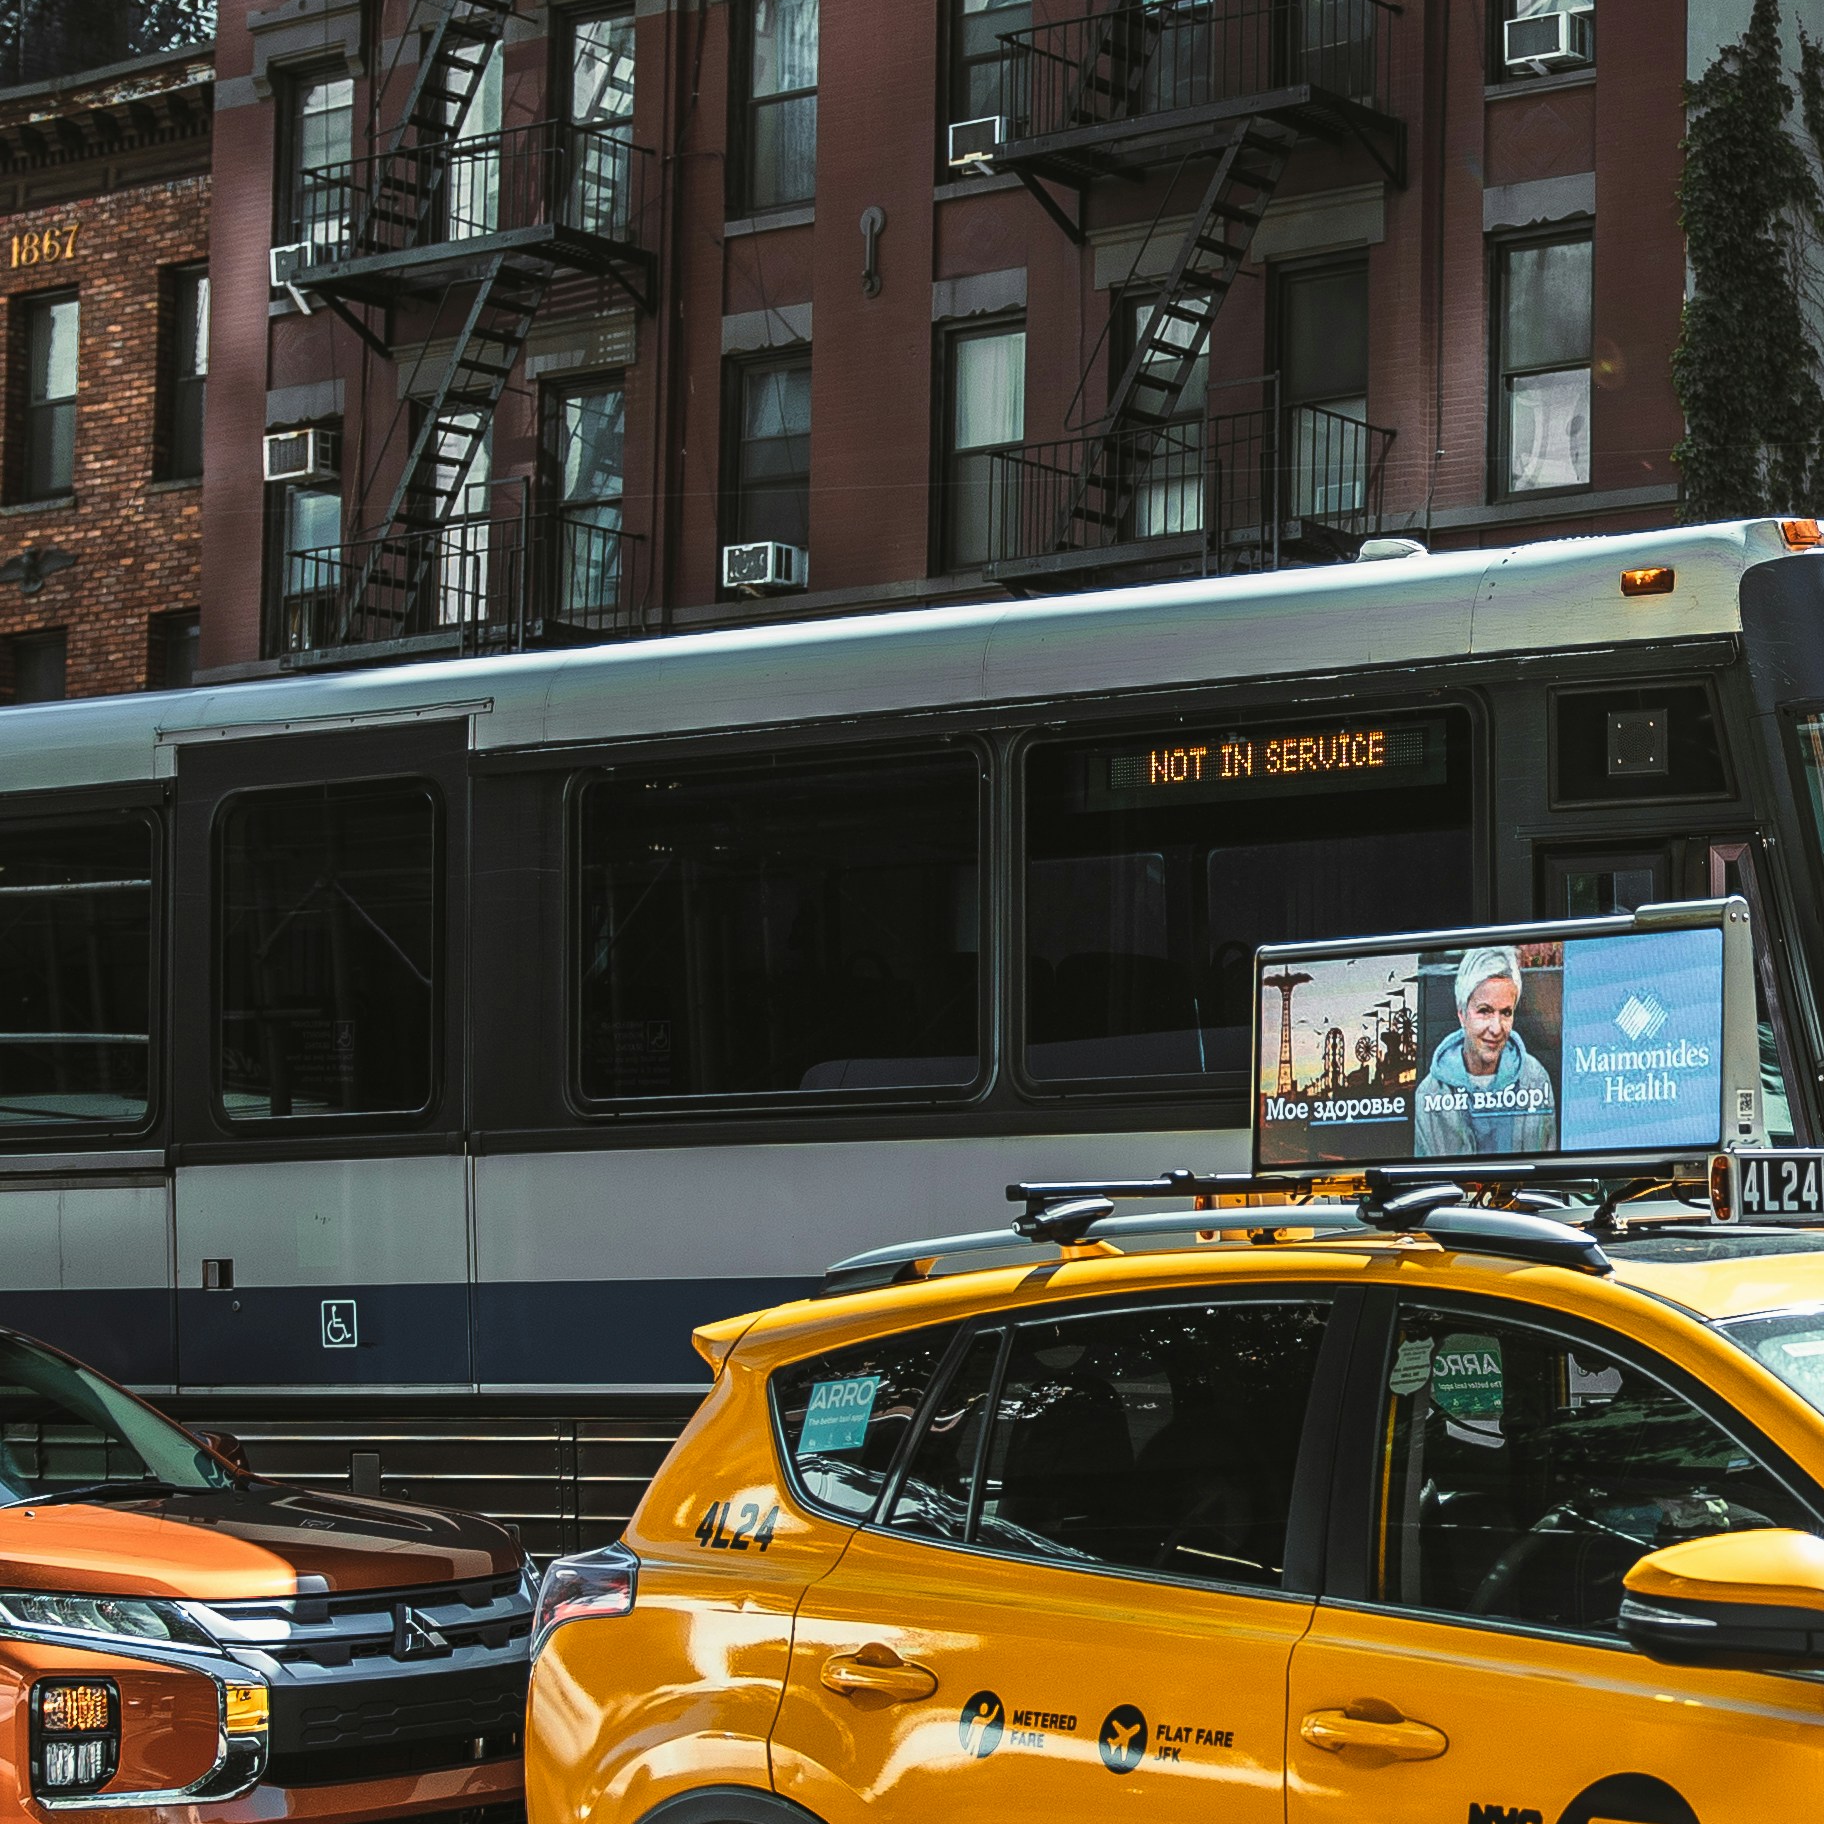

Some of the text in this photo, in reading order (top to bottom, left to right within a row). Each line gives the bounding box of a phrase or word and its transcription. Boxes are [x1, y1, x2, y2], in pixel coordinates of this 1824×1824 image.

[11, 220, 79, 269] 1867
[1151, 731, 1384, 784] NOT IN SERVICE
[1575, 1039, 1709, 1073] Maimonides
[1266, 1083, 1550, 1122] Мое здоровье мой выбор!
[1603, 1072, 1677, 1104] Health
[1744, 1161, 1819, 1212] 4L24
[809, 1380, 875, 1411] ARRO
[694, 1501, 780, 1552] 4L24
[1012, 1710, 1078, 1732] METERED
[1156, 1724, 1235, 1748] FLAT FARE
[1010, 1730, 1045, 1749] FARE
[1154, 1746, 1181, 1763] JFK
